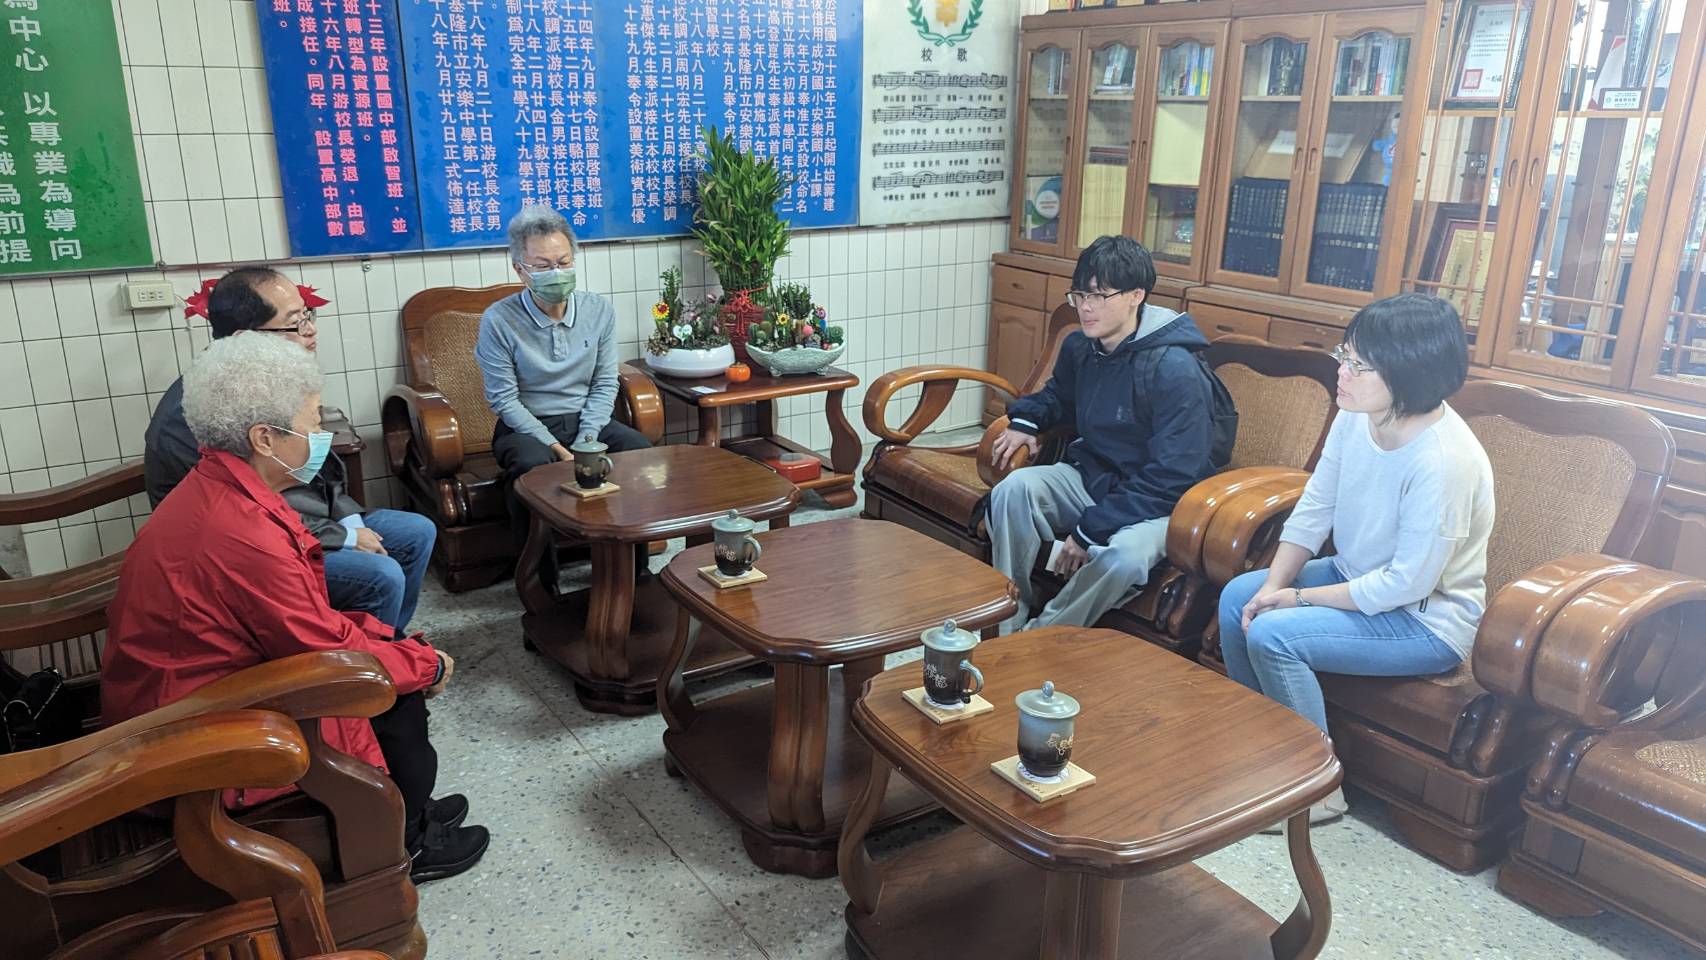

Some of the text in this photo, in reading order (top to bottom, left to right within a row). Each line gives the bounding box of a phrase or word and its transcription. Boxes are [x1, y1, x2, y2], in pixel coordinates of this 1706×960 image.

[658, 0, 677, 221] 十年二月二十七日周校長榮調
[921, 47, 968, 62] 校歌
[23, 91, 82, 261] 以專業為導向
